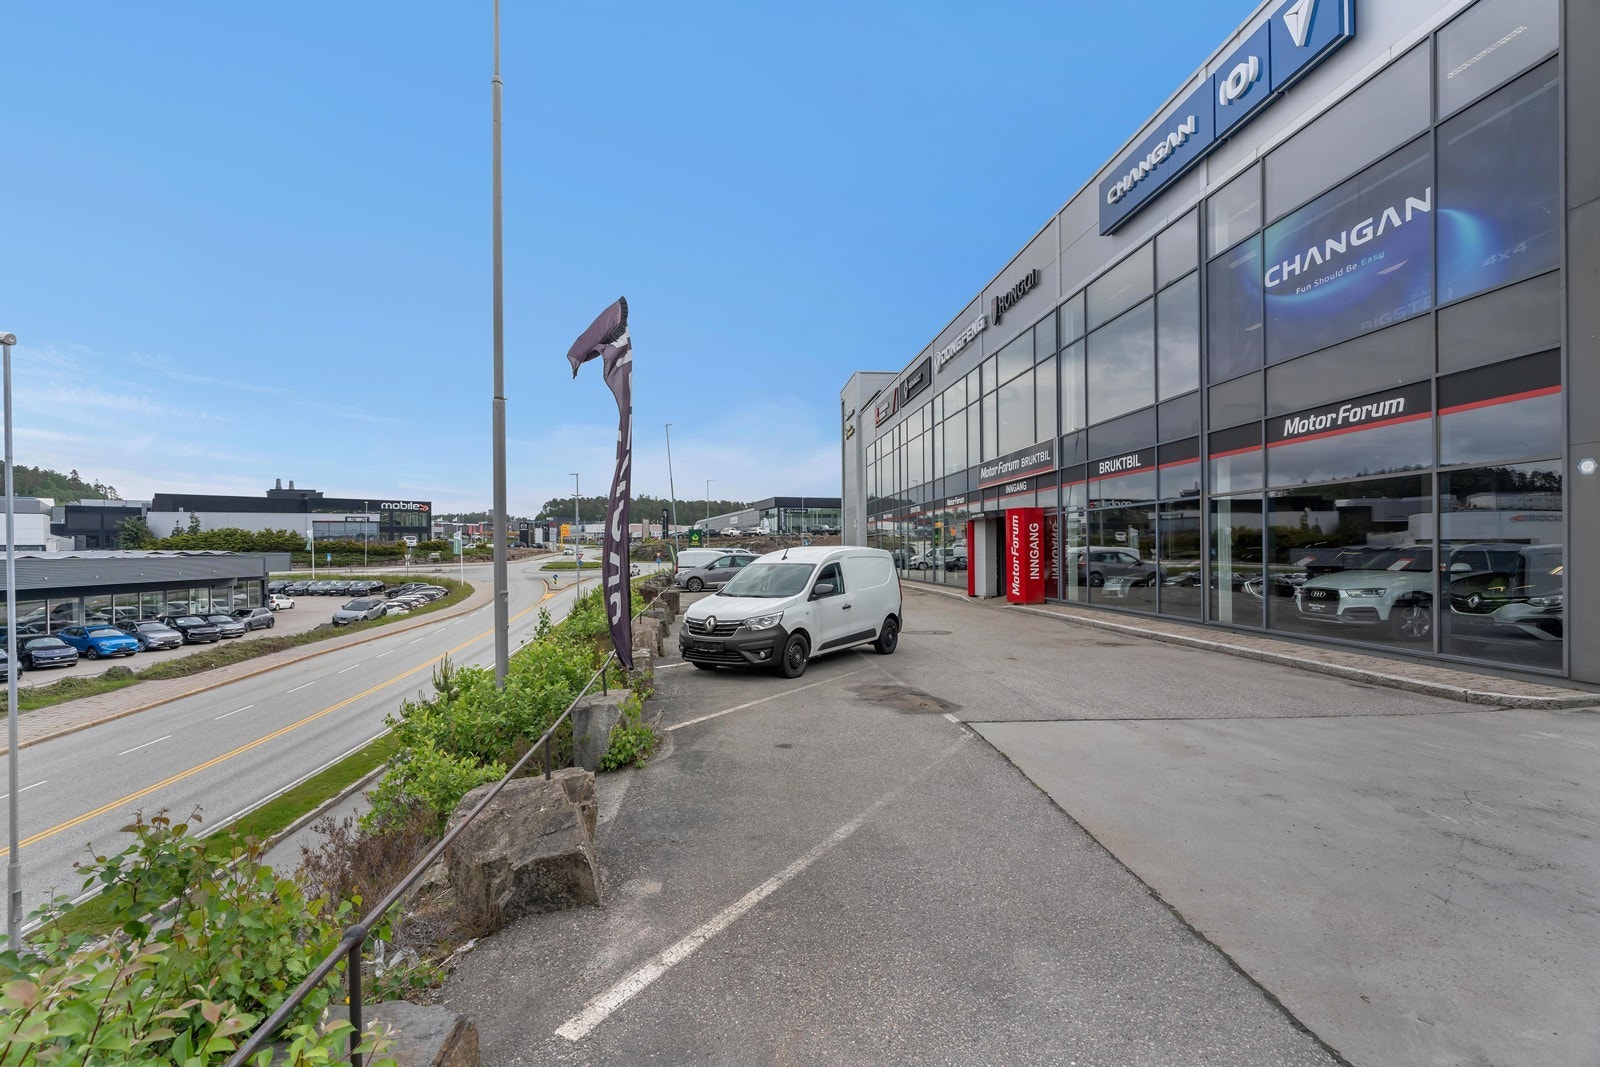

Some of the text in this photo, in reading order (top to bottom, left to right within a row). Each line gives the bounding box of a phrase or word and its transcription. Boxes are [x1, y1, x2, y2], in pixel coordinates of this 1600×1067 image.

[1107, 115, 1196, 204] CHANGAN
[1265, 187, 1432, 289] CHANGAN
[1296, 251, 1385, 295] Fun Should Be Easy
[1021, 450, 1051, 468] BRUKTBIL
[1099, 454, 1141, 475] BRUKTBIL
[1005, 481, 1027, 494] INNGANG
[381, 502, 420, 510] mobile
[1029, 522, 1039, 580] INNGANG
